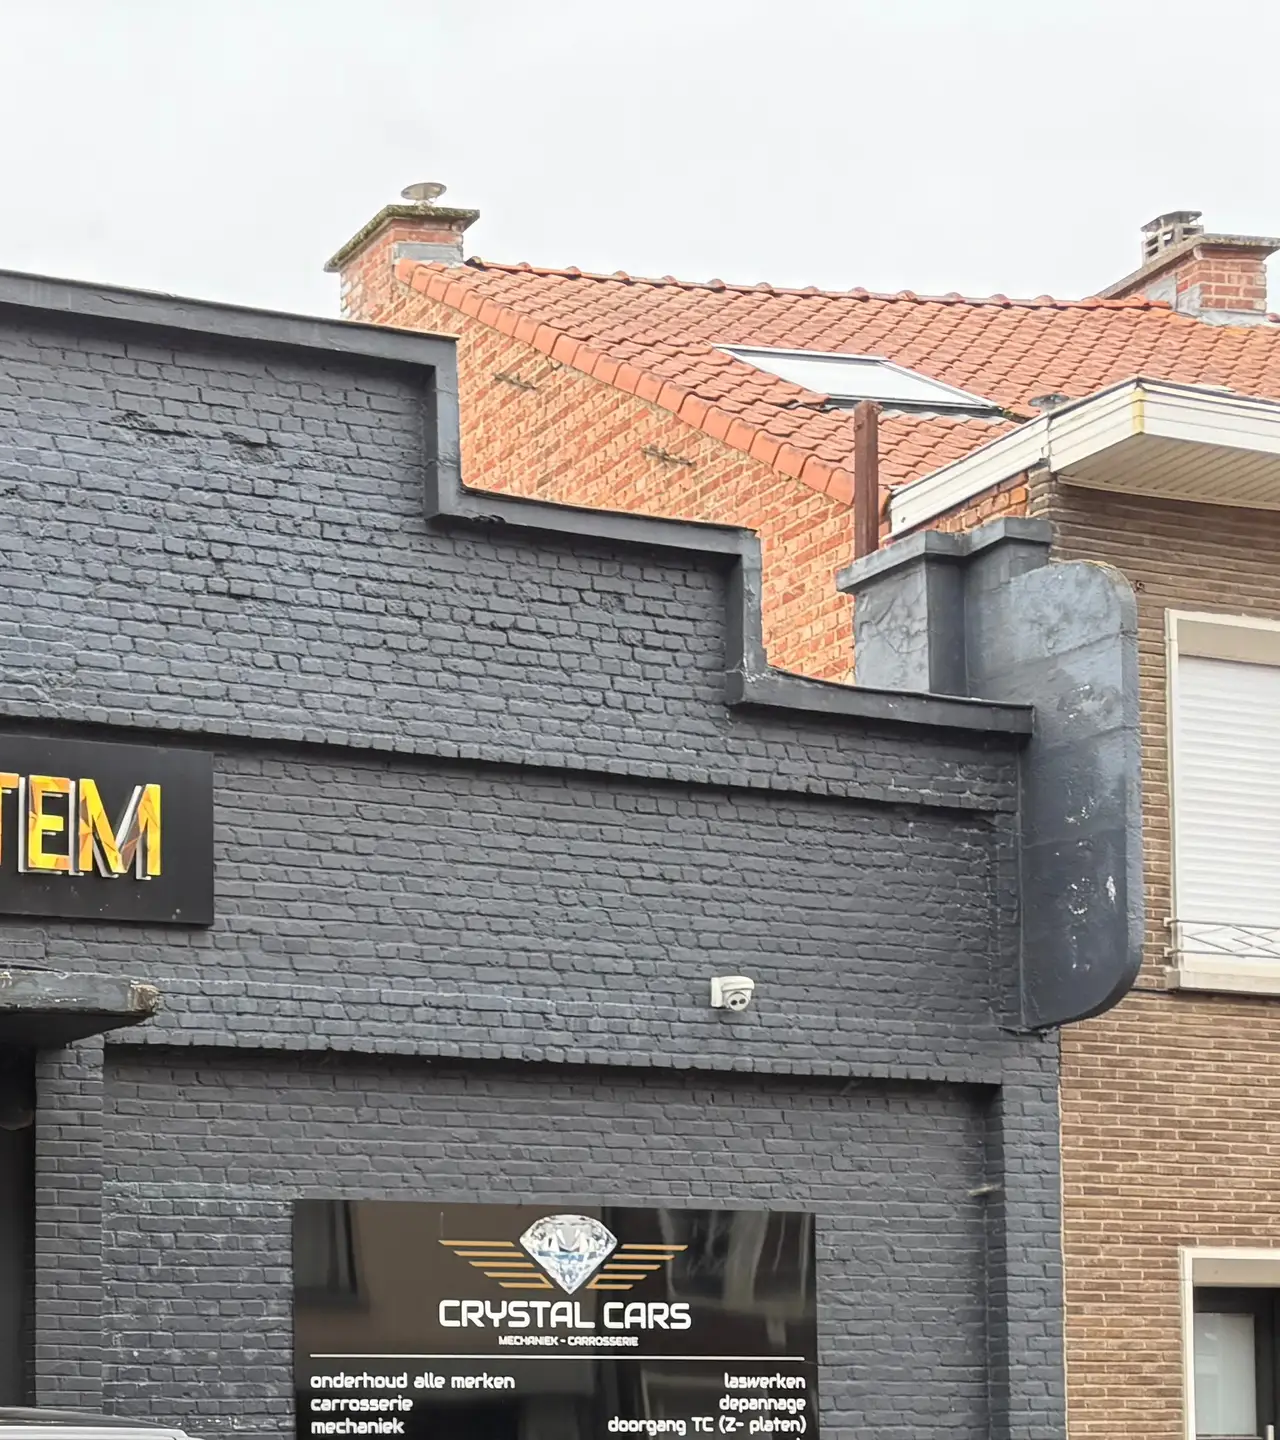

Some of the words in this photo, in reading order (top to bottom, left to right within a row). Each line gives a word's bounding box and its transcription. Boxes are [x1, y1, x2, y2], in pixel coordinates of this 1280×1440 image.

[439, 1300, 595, 1328] CRYSTAL
[604, 1302, 691, 1329] CARS
[499, 1336, 558, 1345] MECHANIEK
[568, 1336, 638, 1346] CARROSSERIE
[311, 1372, 407, 1388] onderhoud
[414, 1372, 445, 1388] alle
[451, 1373, 515, 1388] merken
[725, 1373, 805, 1388] laswerken
[311, 1395, 413, 1411] carrosserie
[720, 1395, 806, 1413] depannage
[312, 1418, 404, 1433] mechaniek
[608, 1416, 686, 1436] doorgang
[691, 1417, 713, 1431] TC
[719, 1415, 744, 1433] (Z-
[750, 1415, 806, 1434] platen)
